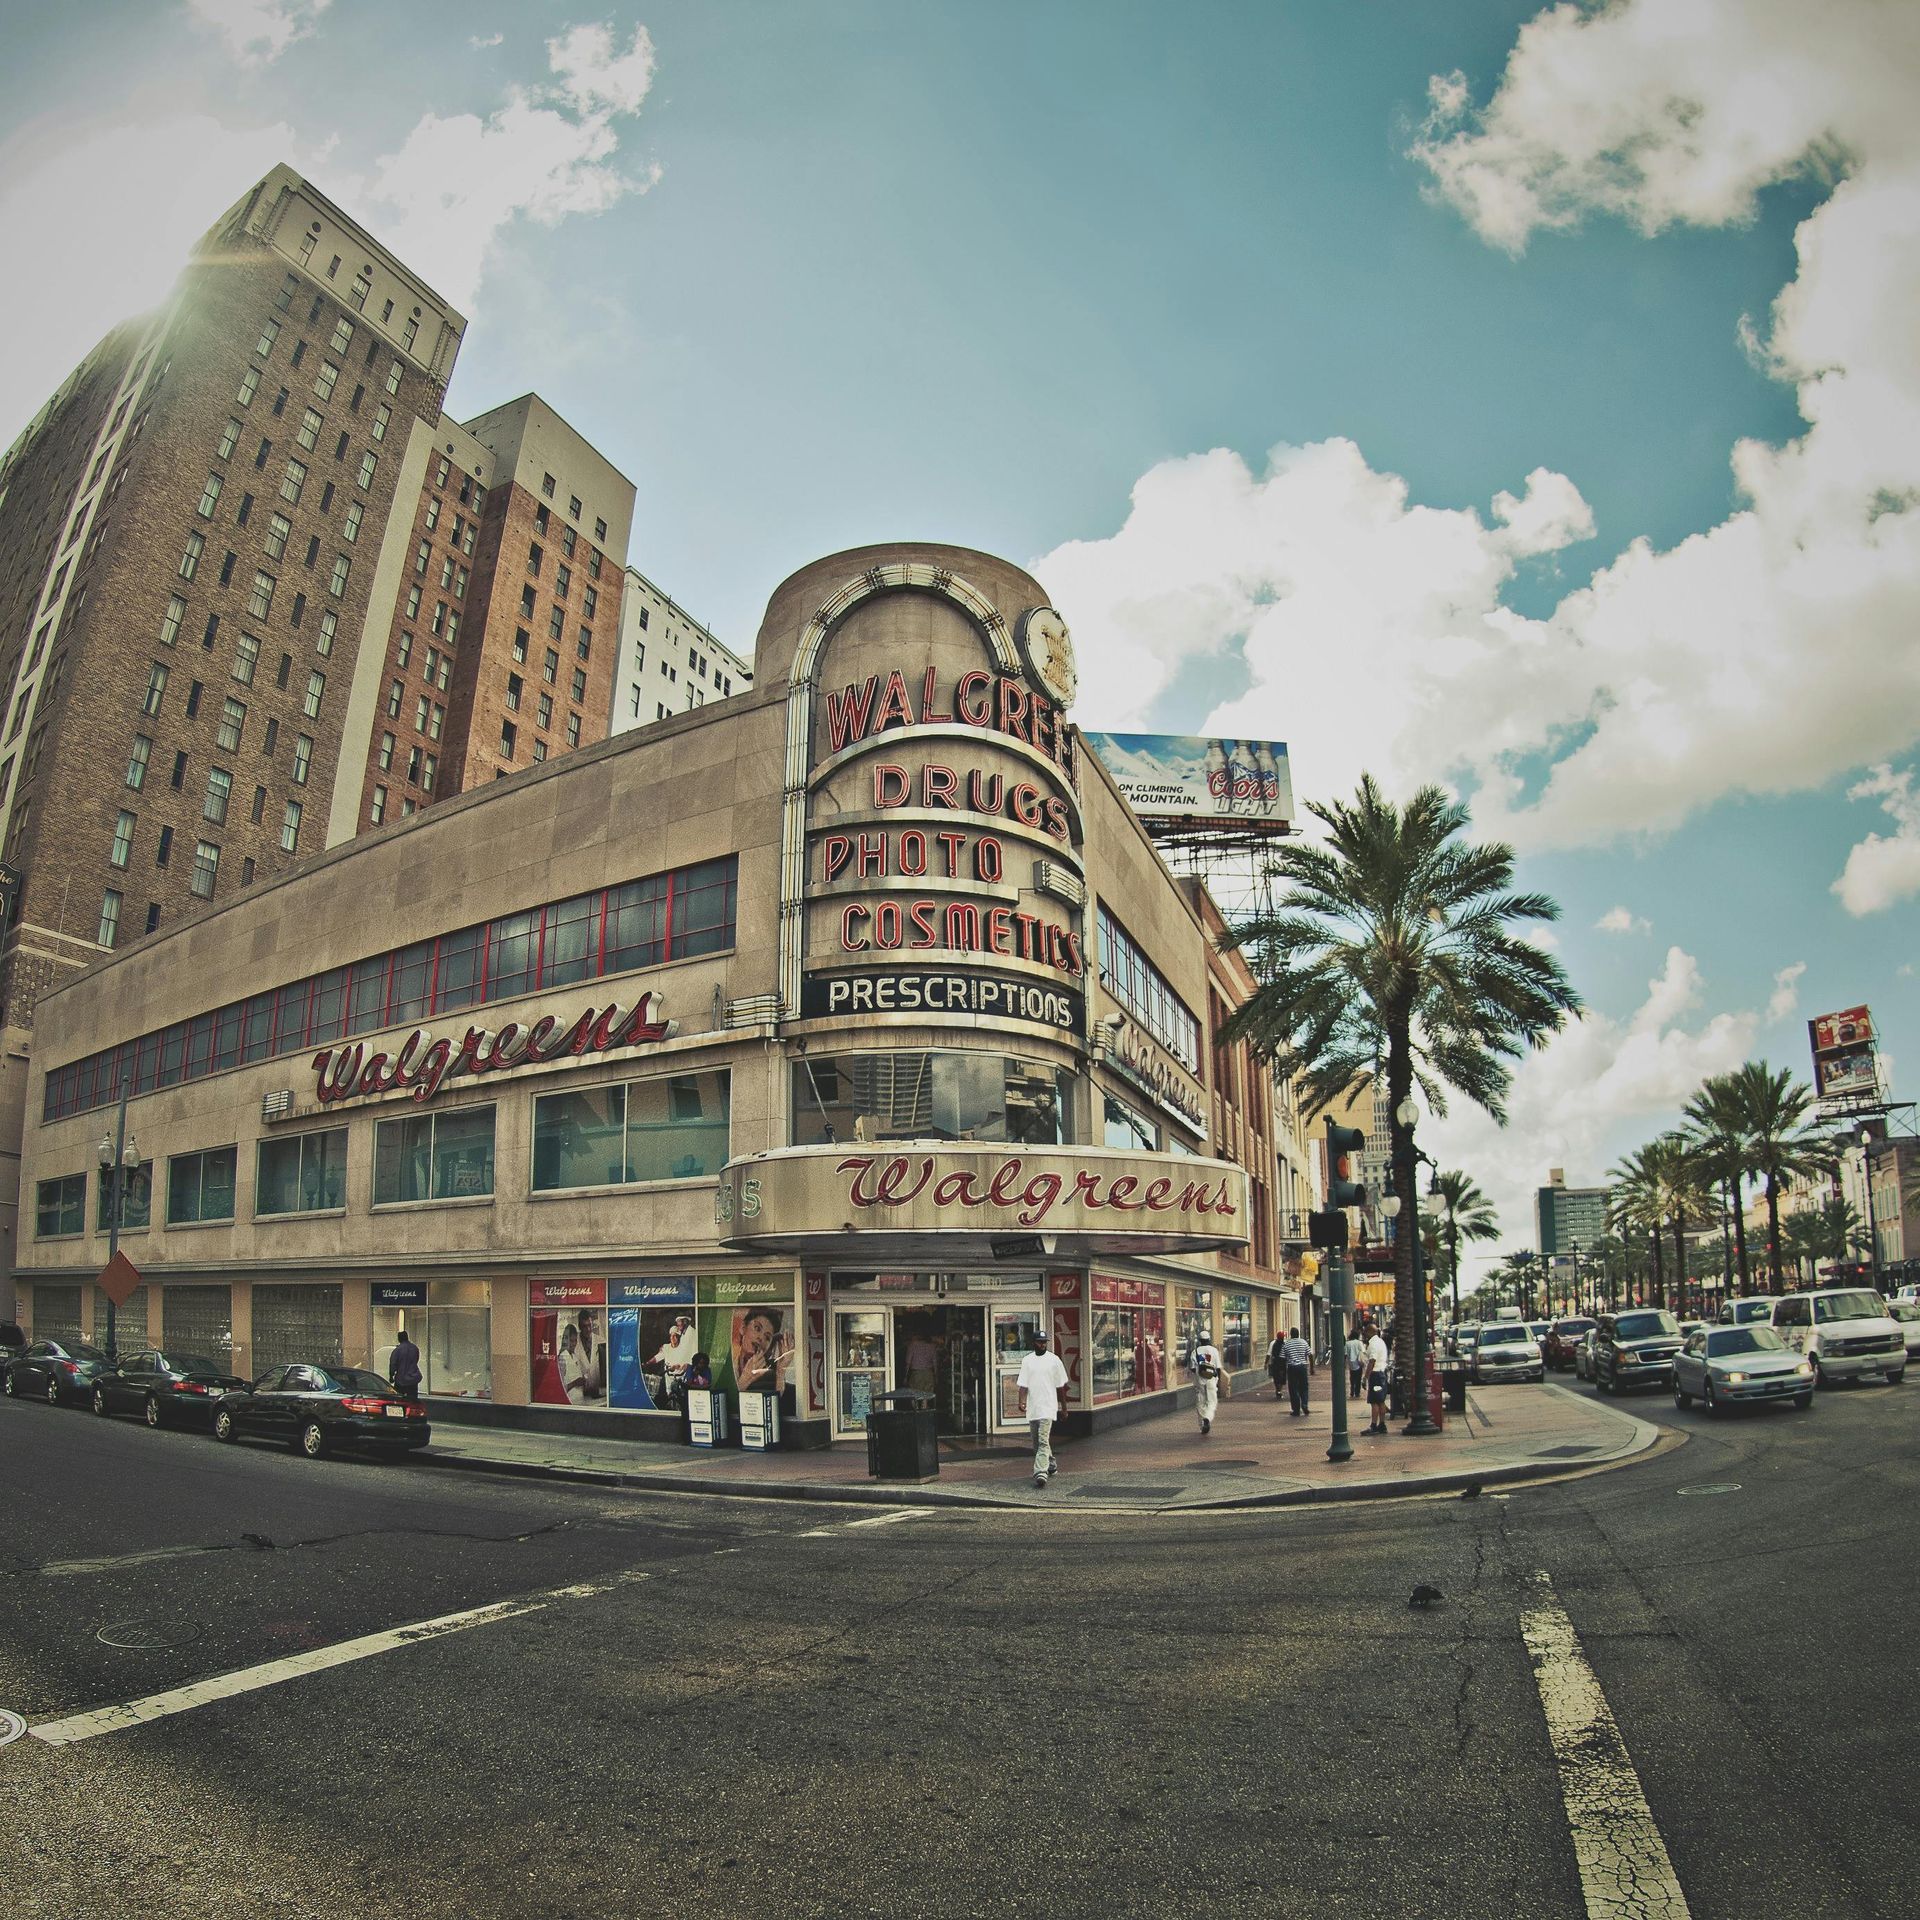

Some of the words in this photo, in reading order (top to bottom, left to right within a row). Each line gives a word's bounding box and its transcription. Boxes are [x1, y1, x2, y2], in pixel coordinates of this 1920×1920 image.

[1136, 785, 1184, 794] CLIMBING
[1208, 768, 1279, 800] Coors
[874, 764, 1069, 842] DRUGS
[1130, 793, 1198, 805] MOUNTAIN.
[1213, 798, 1278, 816] LIGHT
[824, 830, 1003, 884] PHOTO
[841, 900, 1083, 978] COSMETICS
[829, 977, 1074, 1027] PRESCRIPTIONS
[311, 991, 679, 1102] Walgreens
[835, 1157, 1238, 1227] Walgreens
[382, 1289, 417, 1300] Walgreens
[545, 1286, 592, 1299] Walgreens
[624, 1285, 679, 1298] Walgreens
[716, 1281, 776, 1295] Walgreens
[808, 1279, 821, 1295] W
[1056, 1278, 1076, 1295] W
